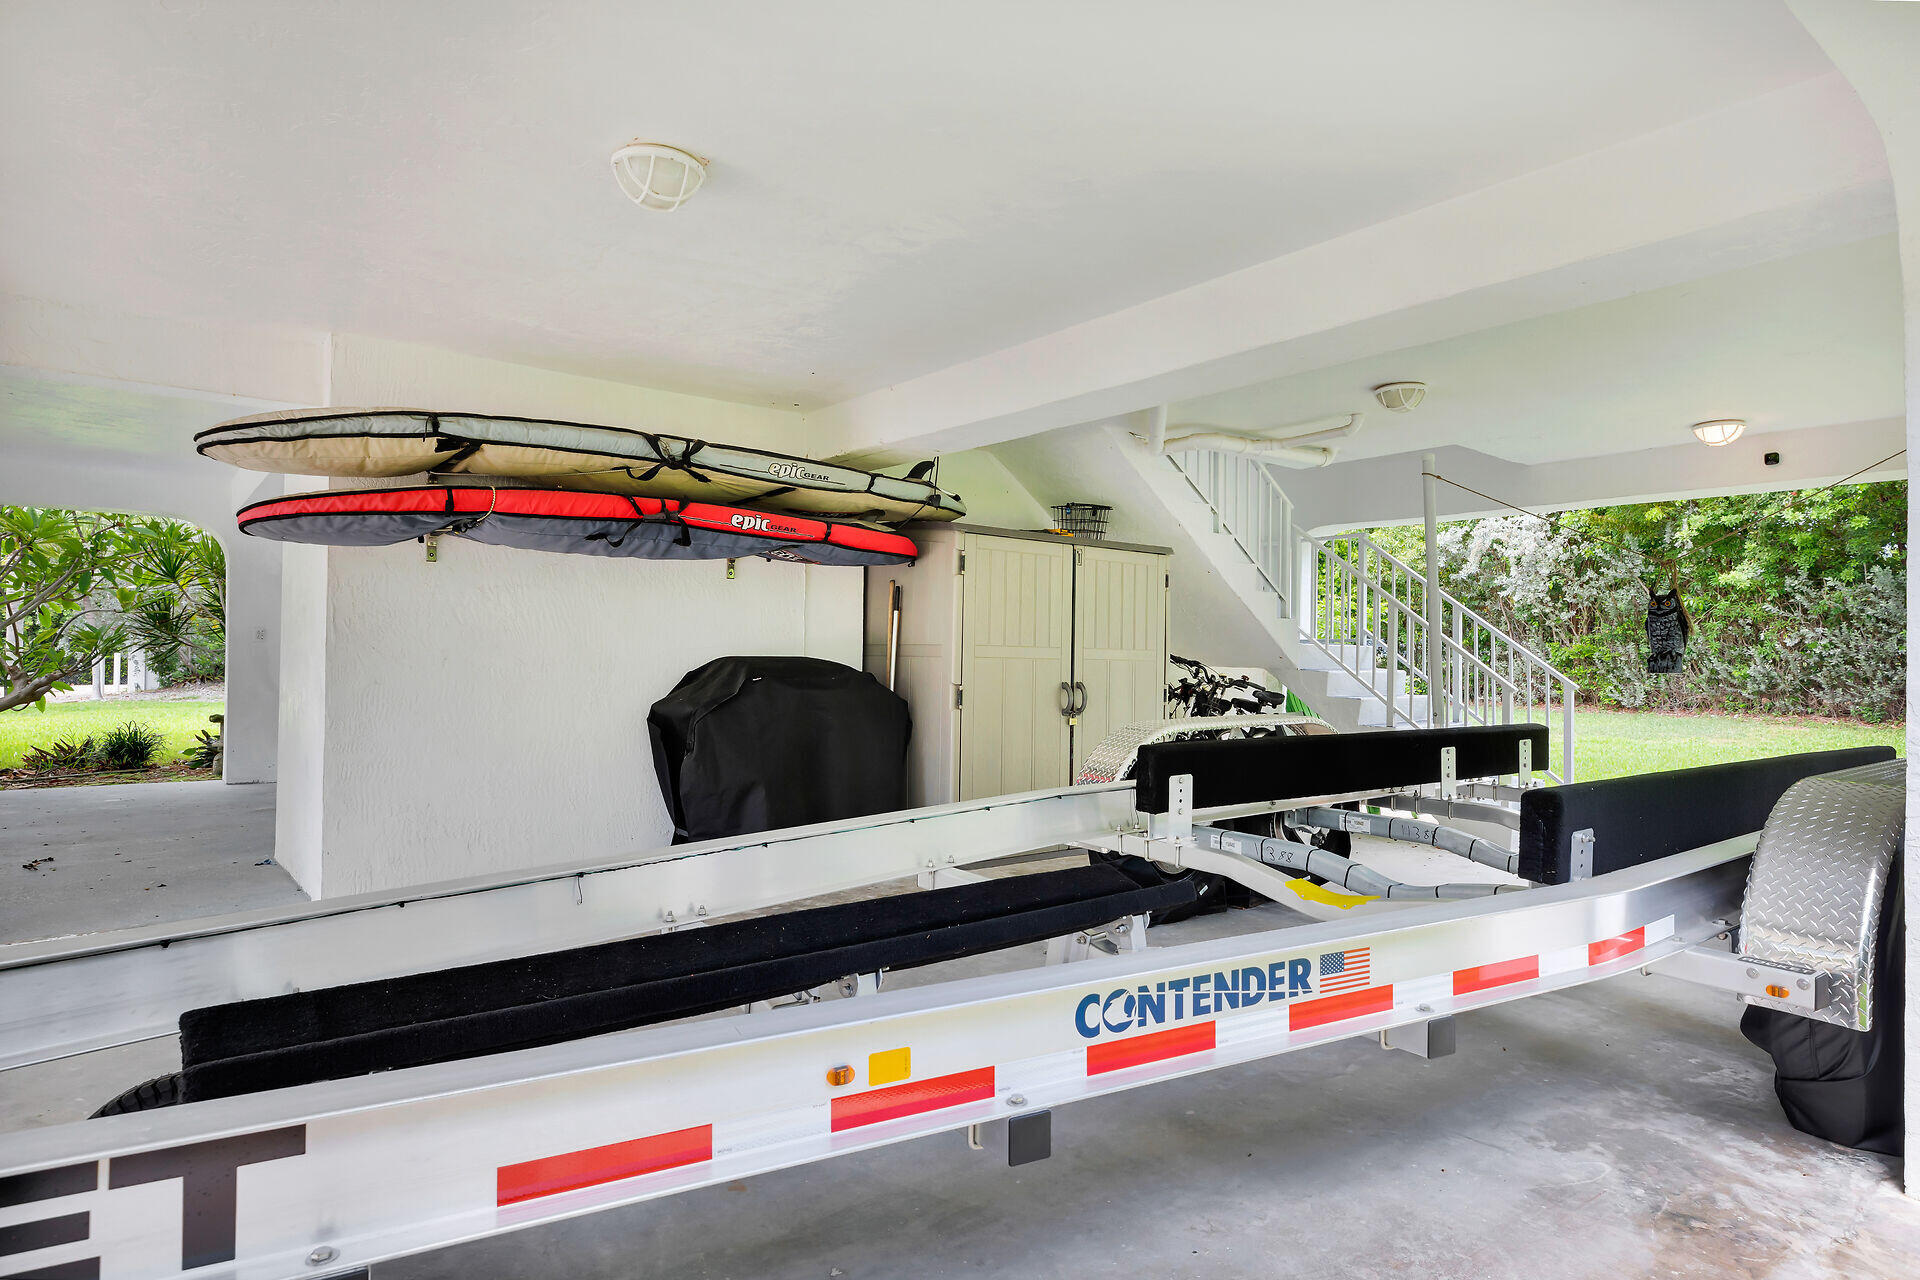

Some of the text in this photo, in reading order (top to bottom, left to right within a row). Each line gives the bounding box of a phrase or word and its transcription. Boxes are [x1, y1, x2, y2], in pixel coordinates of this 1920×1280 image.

[768, 462, 829, 480] epic GEAR
[731, 513, 770, 531] epic
[1075, 957, 1313, 1039] CONTENDER
